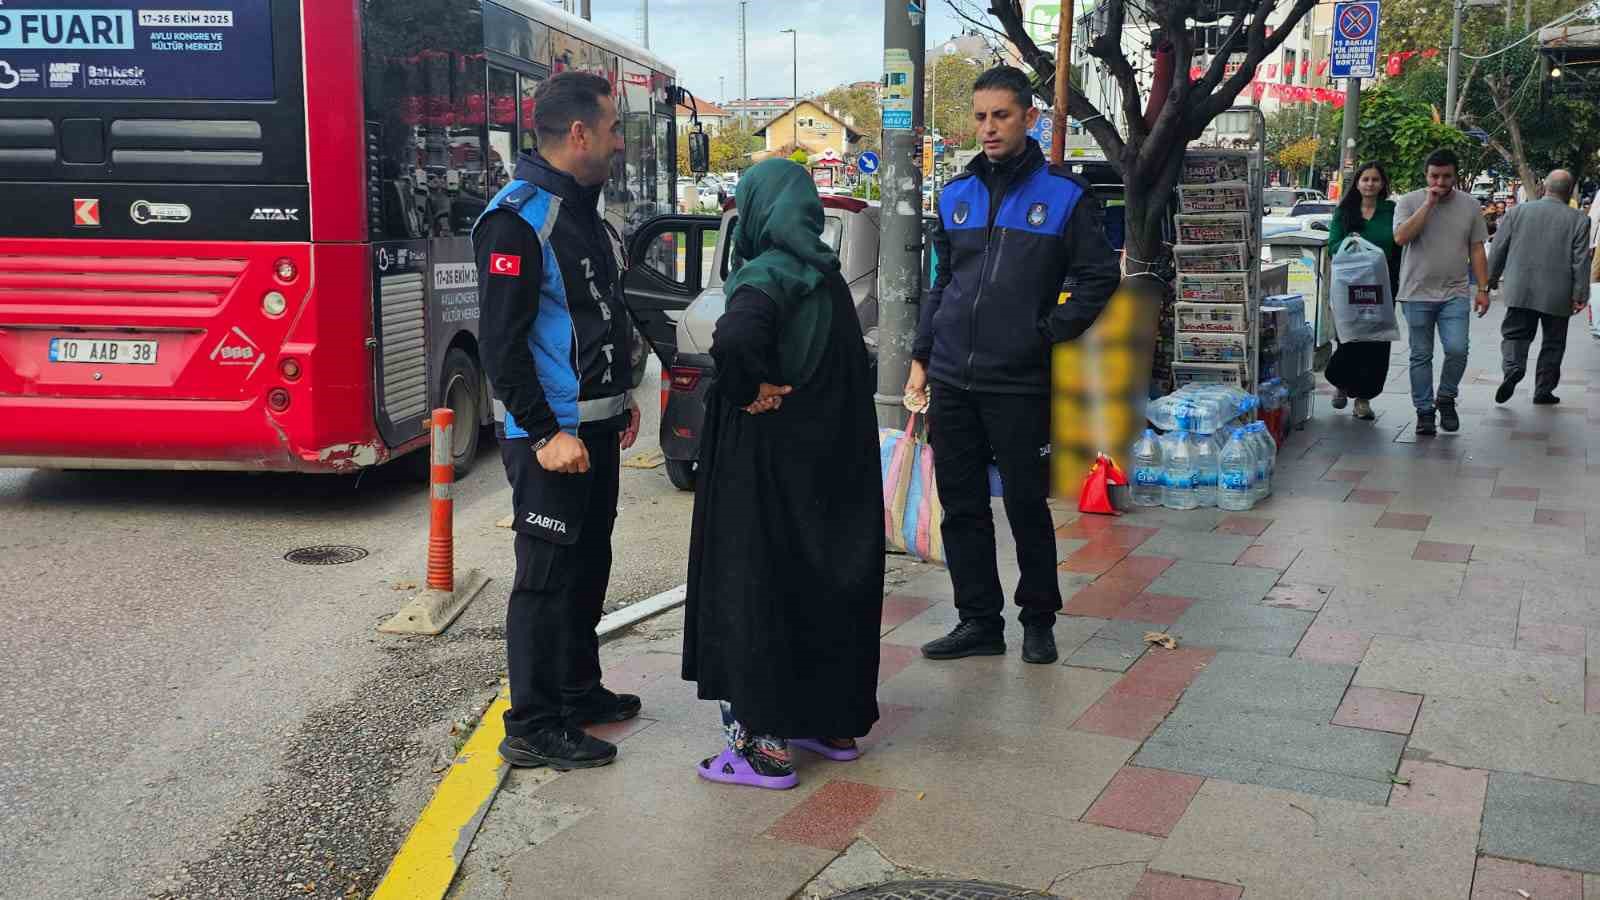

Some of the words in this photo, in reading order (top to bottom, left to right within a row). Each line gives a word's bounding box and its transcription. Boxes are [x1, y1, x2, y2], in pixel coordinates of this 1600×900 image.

[143, 14, 170, 23] 17-26
[173, 11, 201, 23] EKİM
[203, 15, 229, 23] 2025
[21, 15, 124, 44] FUARI
[150, 32, 172, 40] AVLU
[174, 32, 209, 40] KONGRE
[151, 41, 184, 50] KÜLTÜR
[185, 41, 223, 50] MERKEZİ
[250, 208, 299, 220] ATAK
[581, 258, 615, 384] ZABTA
[63, 342, 77, 359] 10
[89, 342, 118, 360] AAB
[132, 343, 150, 361] 38
[525, 512, 566, 533] ZABITA
